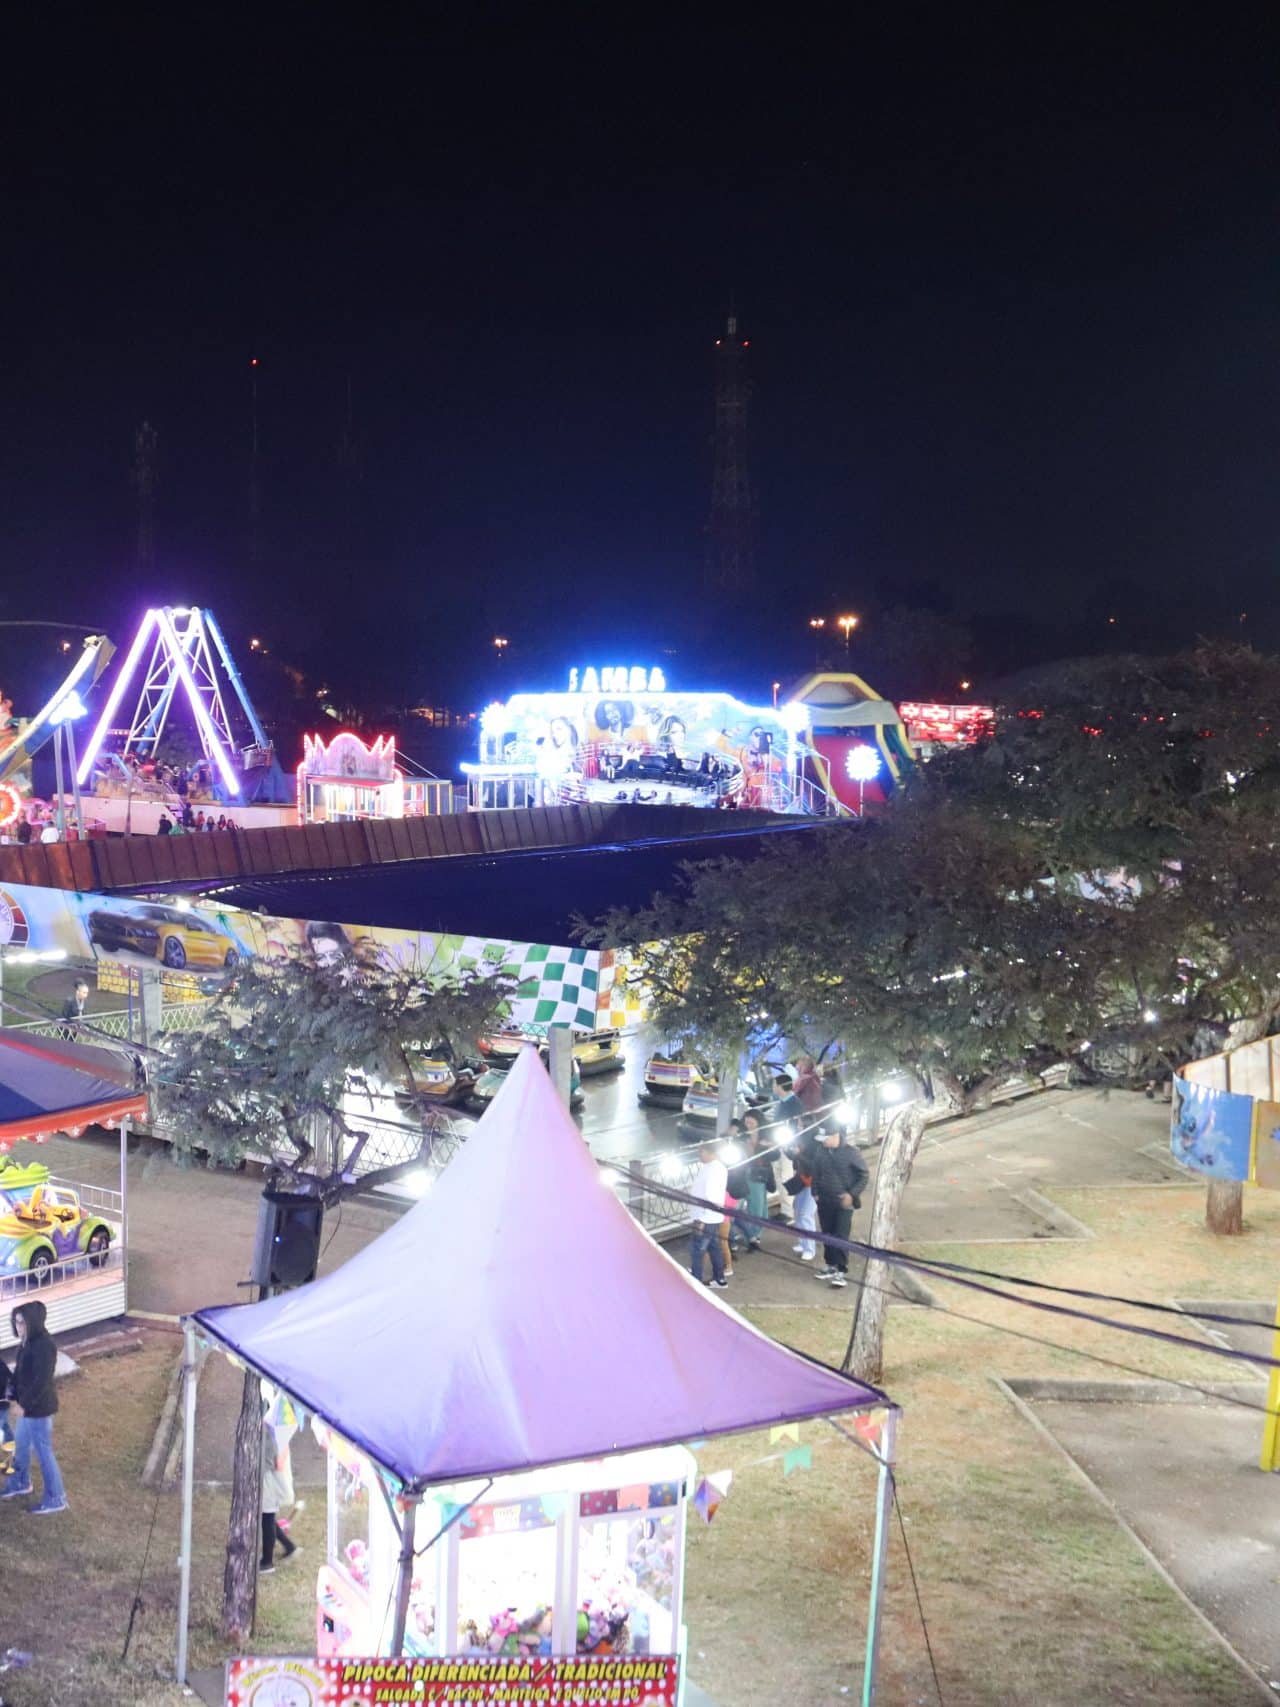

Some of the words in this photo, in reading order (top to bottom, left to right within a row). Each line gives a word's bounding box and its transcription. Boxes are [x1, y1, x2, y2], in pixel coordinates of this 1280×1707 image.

[342, 1664, 408, 1682] PIPOCA
[411, 1663, 532, 1682] DIFERENCIADA
[554, 1662, 666, 1681] TRADICIONAL
[375, 1687, 425, 1702] SALGADA
[492, 1687, 550, 1701] MANTEIGA
